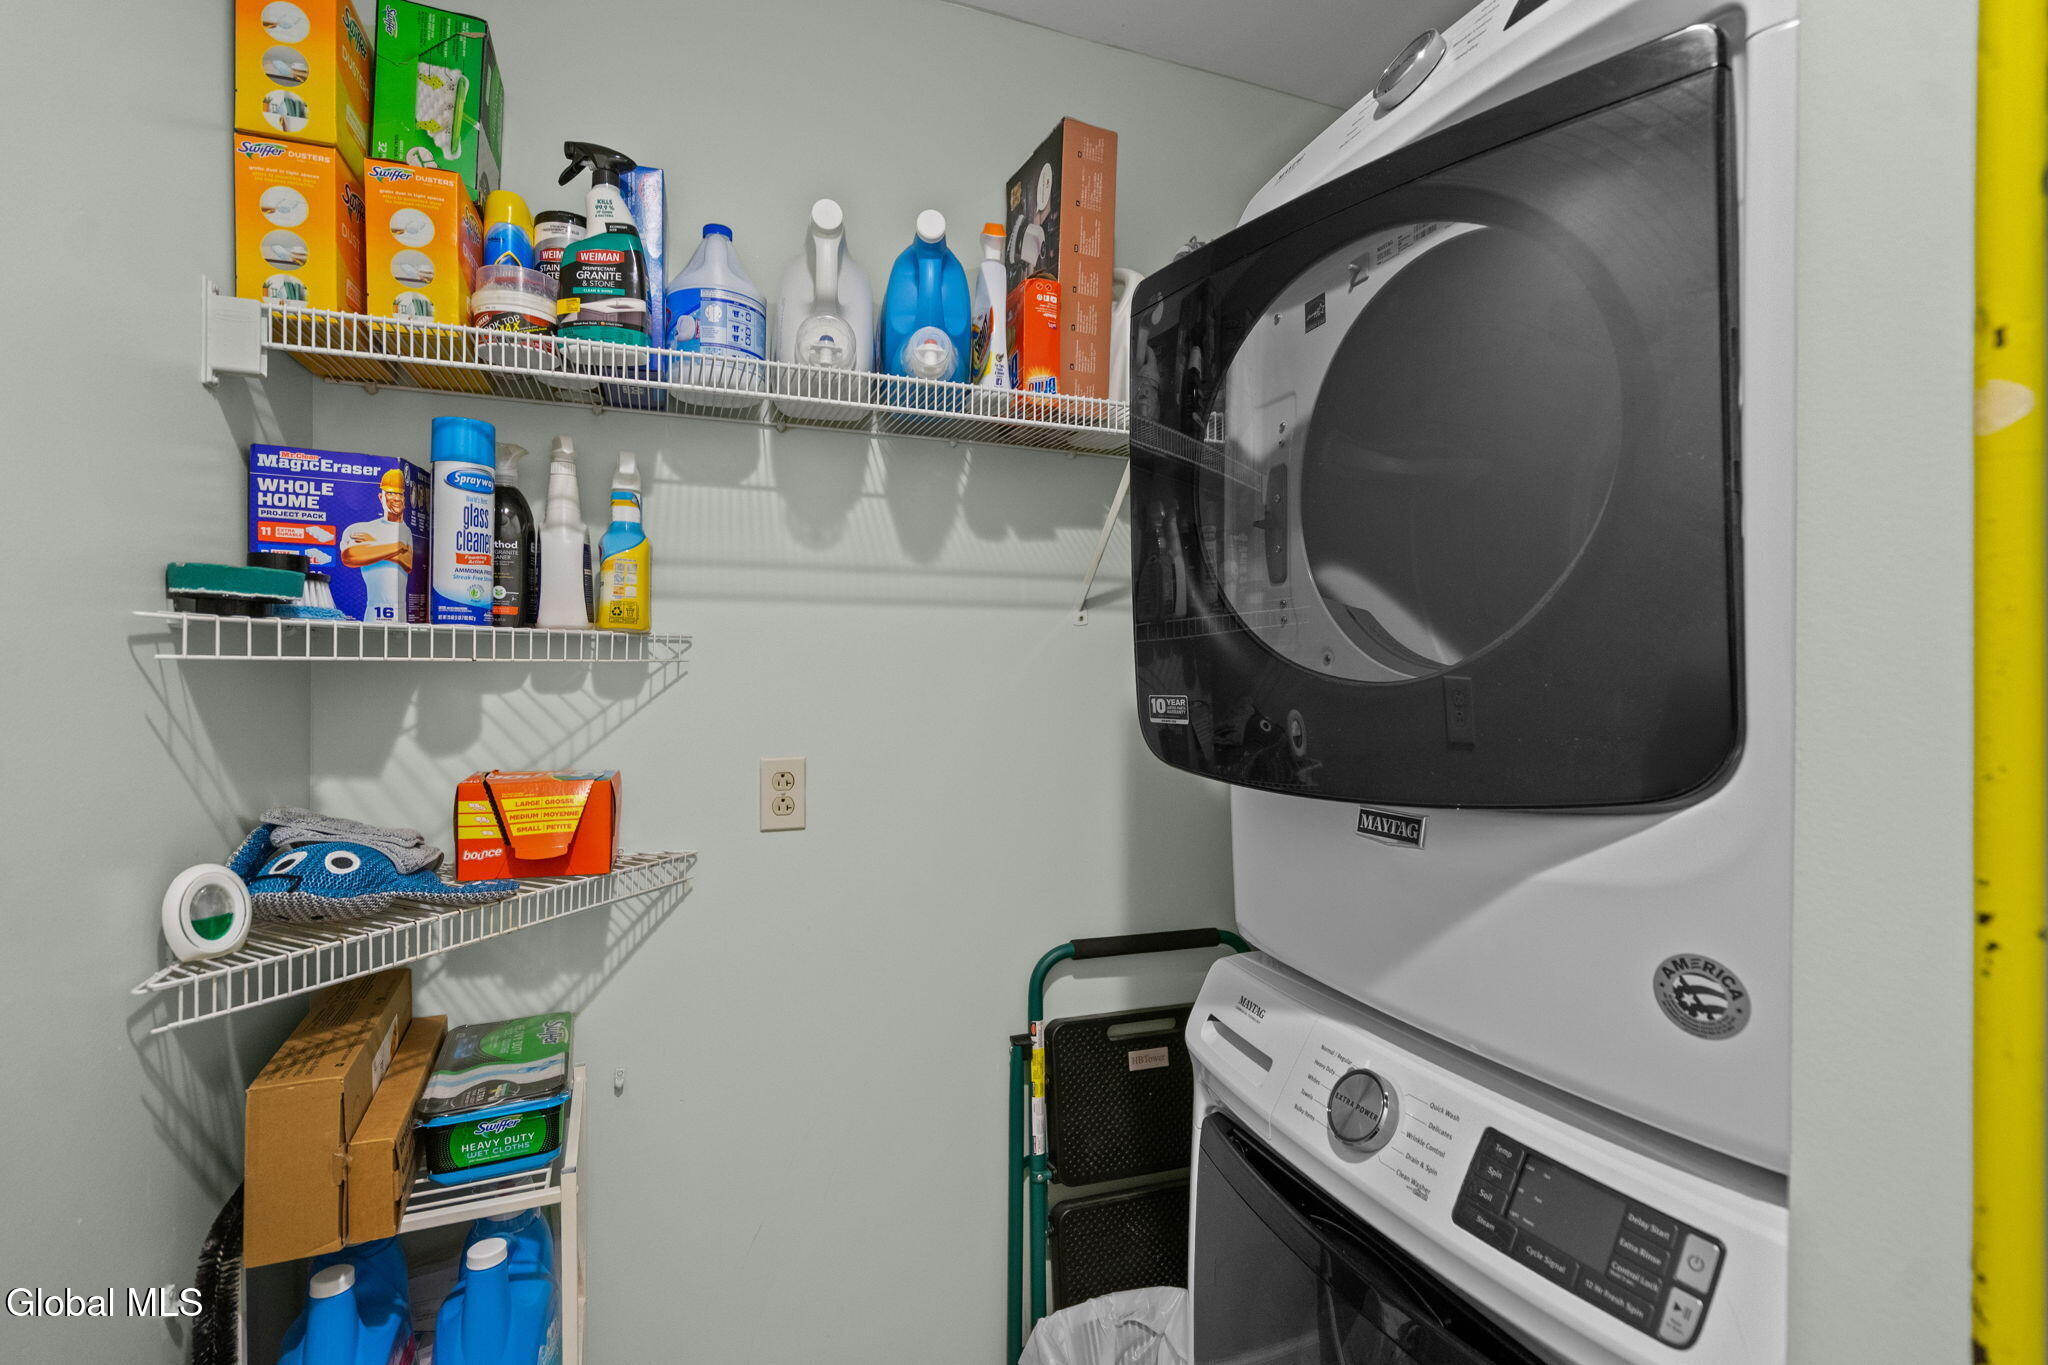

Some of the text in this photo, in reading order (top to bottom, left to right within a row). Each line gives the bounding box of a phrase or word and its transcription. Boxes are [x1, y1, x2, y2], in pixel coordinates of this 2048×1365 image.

[383, 5, 397, 37] Swiffer
[238, 141, 330, 163] Swiffer DUSTERS
[368, 166, 454, 187] Swiffer DUSTERS
[542, 250, 564, 260] WEIM
[580, 252, 620, 262] WEIMAN
[576, 271, 622, 281] GRANITE
[502, 314, 520, 325] TOP
[257, 477, 334, 496] WHOLE
[257, 492, 320, 509] HOME
[260, 510, 324, 519] PROJECT PACK
[464, 503, 489, 529] glass
[261, 527, 271, 536] 11
[456, 530, 491, 554] cleaner
[494, 540, 518, 549] thod
[454, 567, 483, 575] AMMONIA
[374, 606, 394, 618] 16
[1151, 698, 1186, 714] 10 YEAR
[515, 798, 575, 808] LARGE GROSSE
[509, 810, 579, 821] MEDIUM MOYENNE
[516, 823, 572, 833] SMALL PETITE
[1360, 813, 1418, 839] MAYTAG
[462, 848, 502, 861] bounce
[1662, 957, 1744, 1001] AMERICA
[1238, 995, 1267, 1019] MAYTAG
[1321, 1044, 1334, 1057] Normal
[1337, 1052, 1353, 1065] Regular
[1314, 1059, 1336, 1076] Heavy Duty
[1307, 1073, 1321, 1085] Whites
[1301, 1088, 1314, 1101] Towels
[1294, 1103, 1315, 1121] Bulky Items
[1335, 1092, 1379, 1122] EXTRA POWER
[1429, 1102, 1460, 1122] Quick Wash
[474, 1117, 521, 1135] Swiffer
[1427, 1122, 1453, 1141] Delicates
[461, 1131, 535, 1153] HEAVY DUTY
[466, 1148, 490, 1159] WET
[492, 1141, 530, 1154] CLOTHS
[1406, 1131, 1446, 1158] Wrinkle Control
[1496, 1143, 1513, 1159] Temp
[1405, 1152, 1438, 1176] Drain & Spin
[1487, 1165, 1502, 1179] Spin
[1396, 1168, 1411, 1181] Clean
[1410, 1177, 1431, 1194] Washer
[1479, 1188, 1493, 1202] Soil
[1476, 1215, 1495, 1231] Steam
[1627, 1212, 1670, 1240] Delay Start
[1526, 1245, 1566, 1274] Cycle Signal
[1619, 1237, 1662, 1266] Extra Rinse
[1611, 1261, 1640, 1281] Control
[1640, 1275, 1660, 1292] Lock
[1604, 1289, 1624, 1307] Fresh
[1625, 1302, 1644, 1319] Spin
